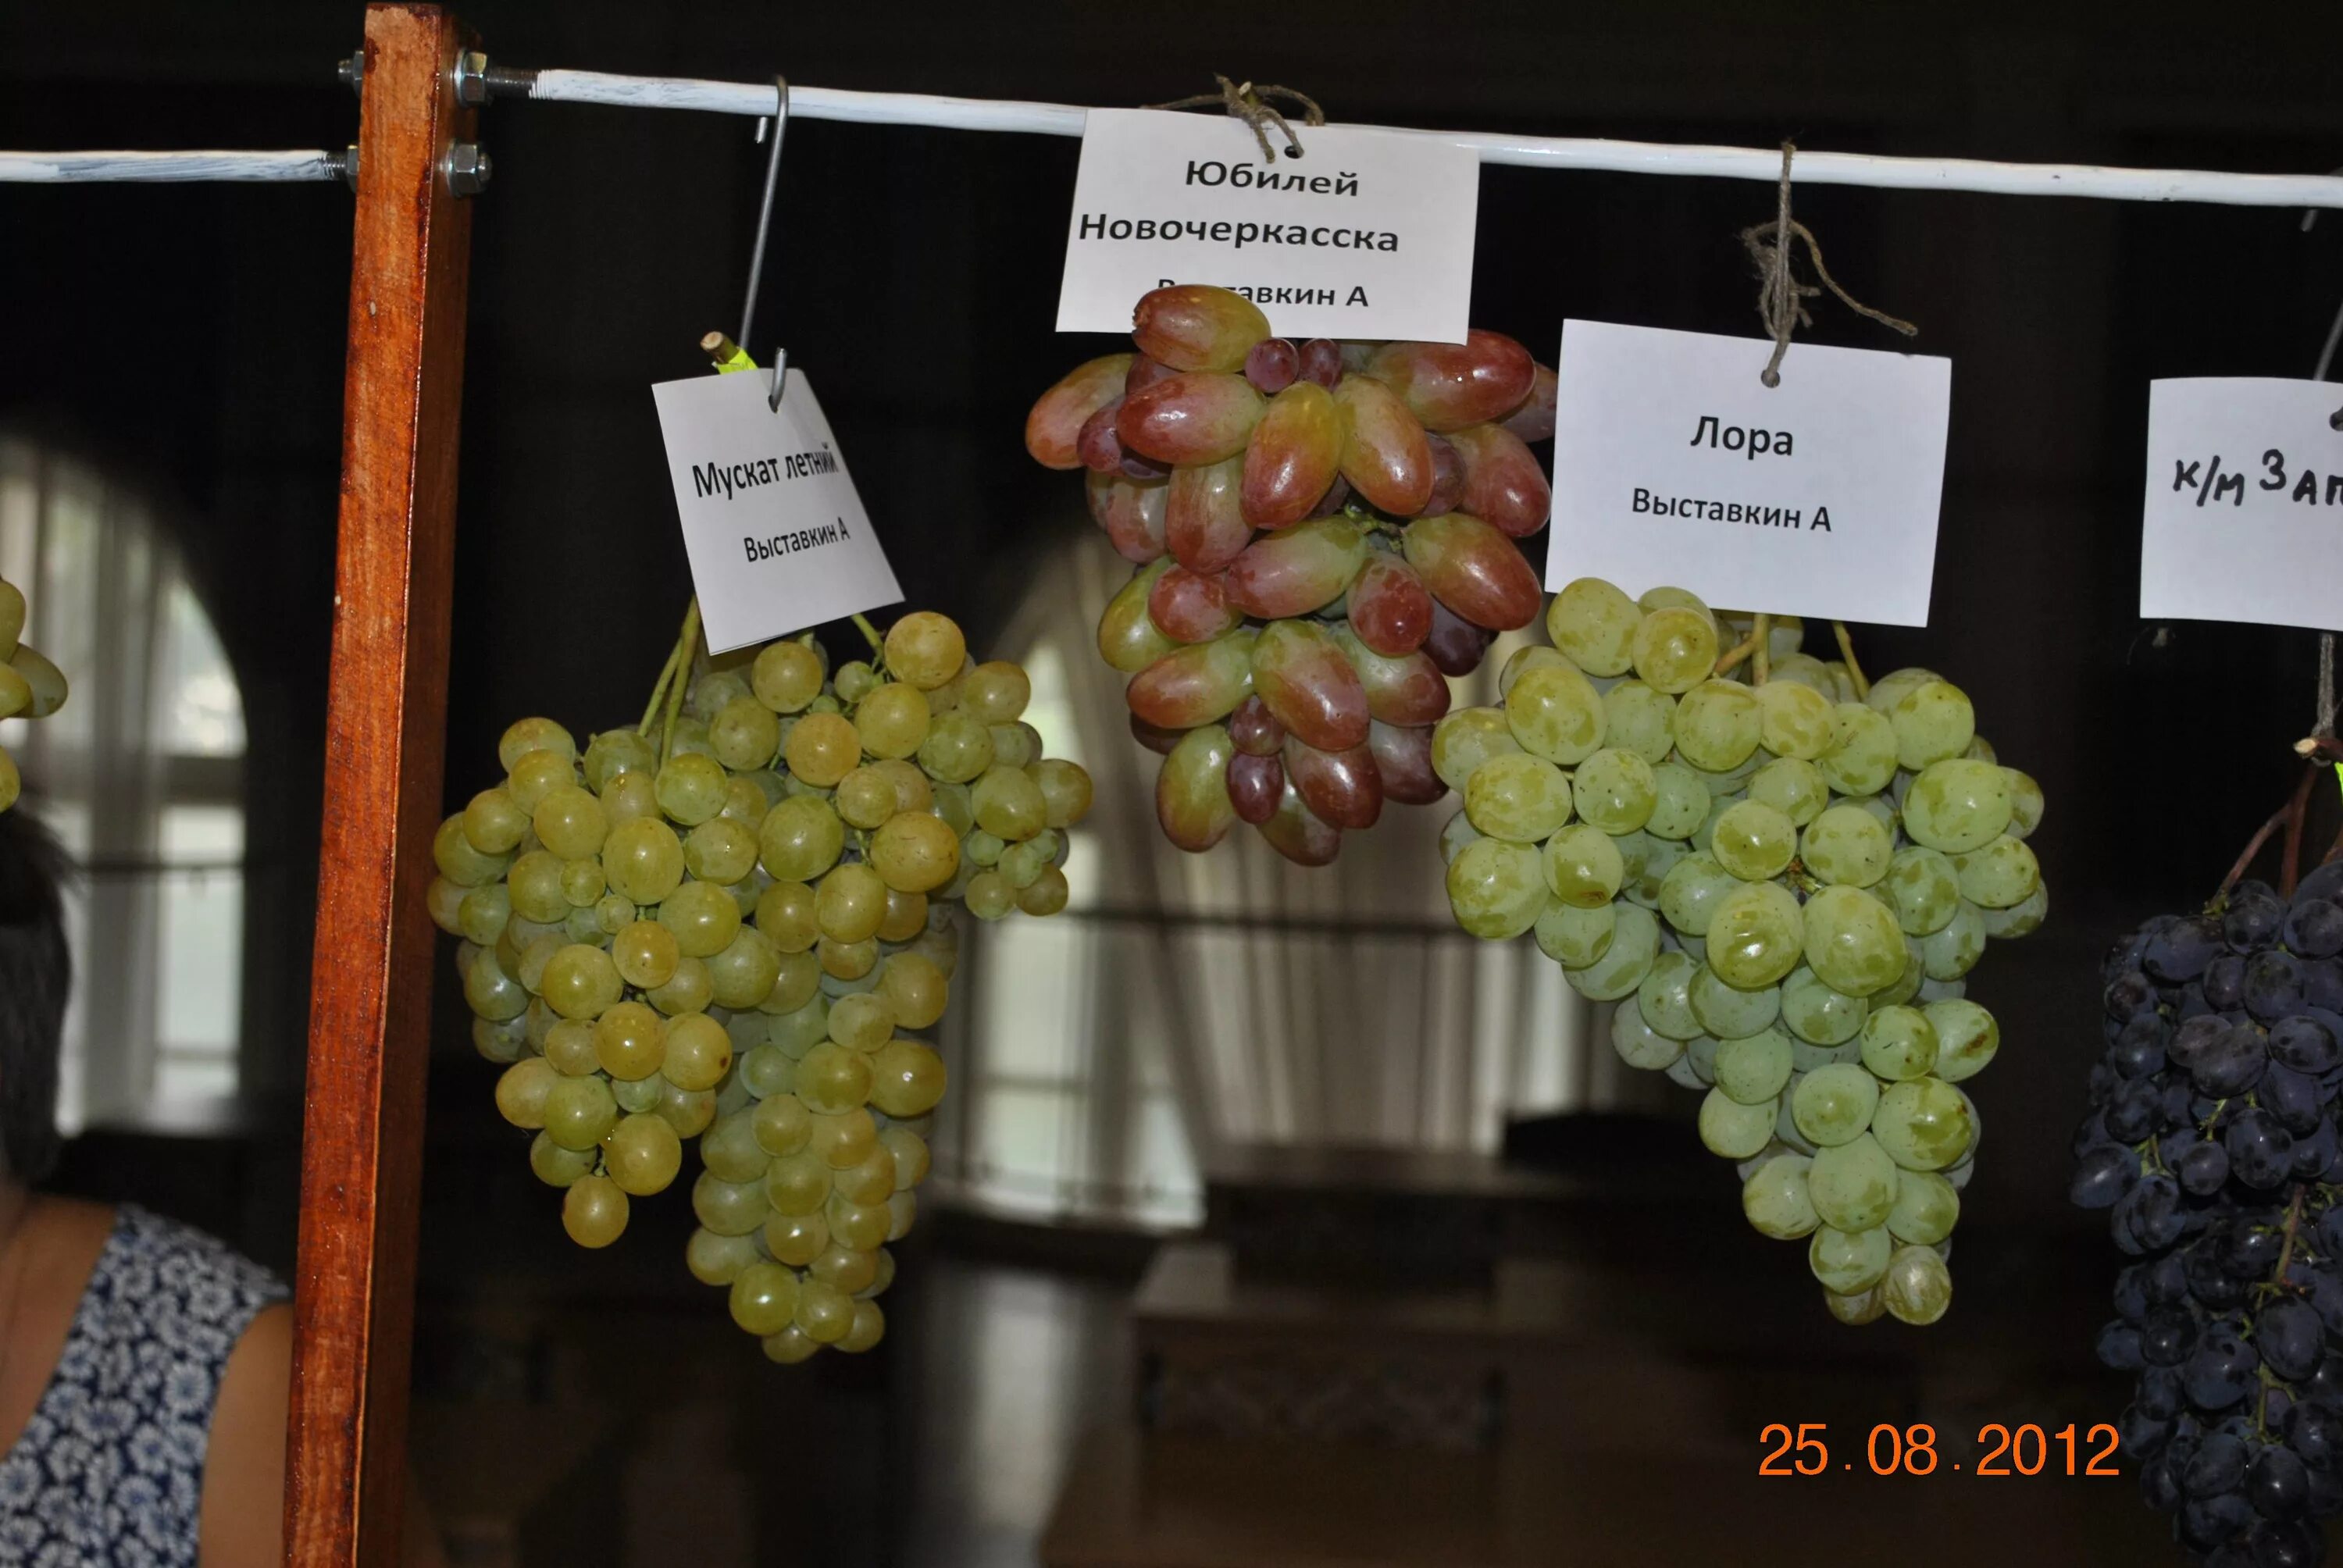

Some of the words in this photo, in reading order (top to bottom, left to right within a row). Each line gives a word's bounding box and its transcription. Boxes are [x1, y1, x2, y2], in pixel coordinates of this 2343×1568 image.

[1185, 160, 1358, 197] Юбилей
[1079, 213, 1399, 252] Новочеркасска
[1158, 279, 1336, 306] авкин
[1346, 286, 1368, 307] А
[1690, 415, 1794, 461] Лора
[692, 458, 780, 501] Мускат
[784, 441, 840, 480] летний
[1632, 487, 1801, 529] Выставкин
[1810, 506, 1832, 532] А
[744, 524, 839, 563] Выставкин
[837, 516, 851, 541] А
